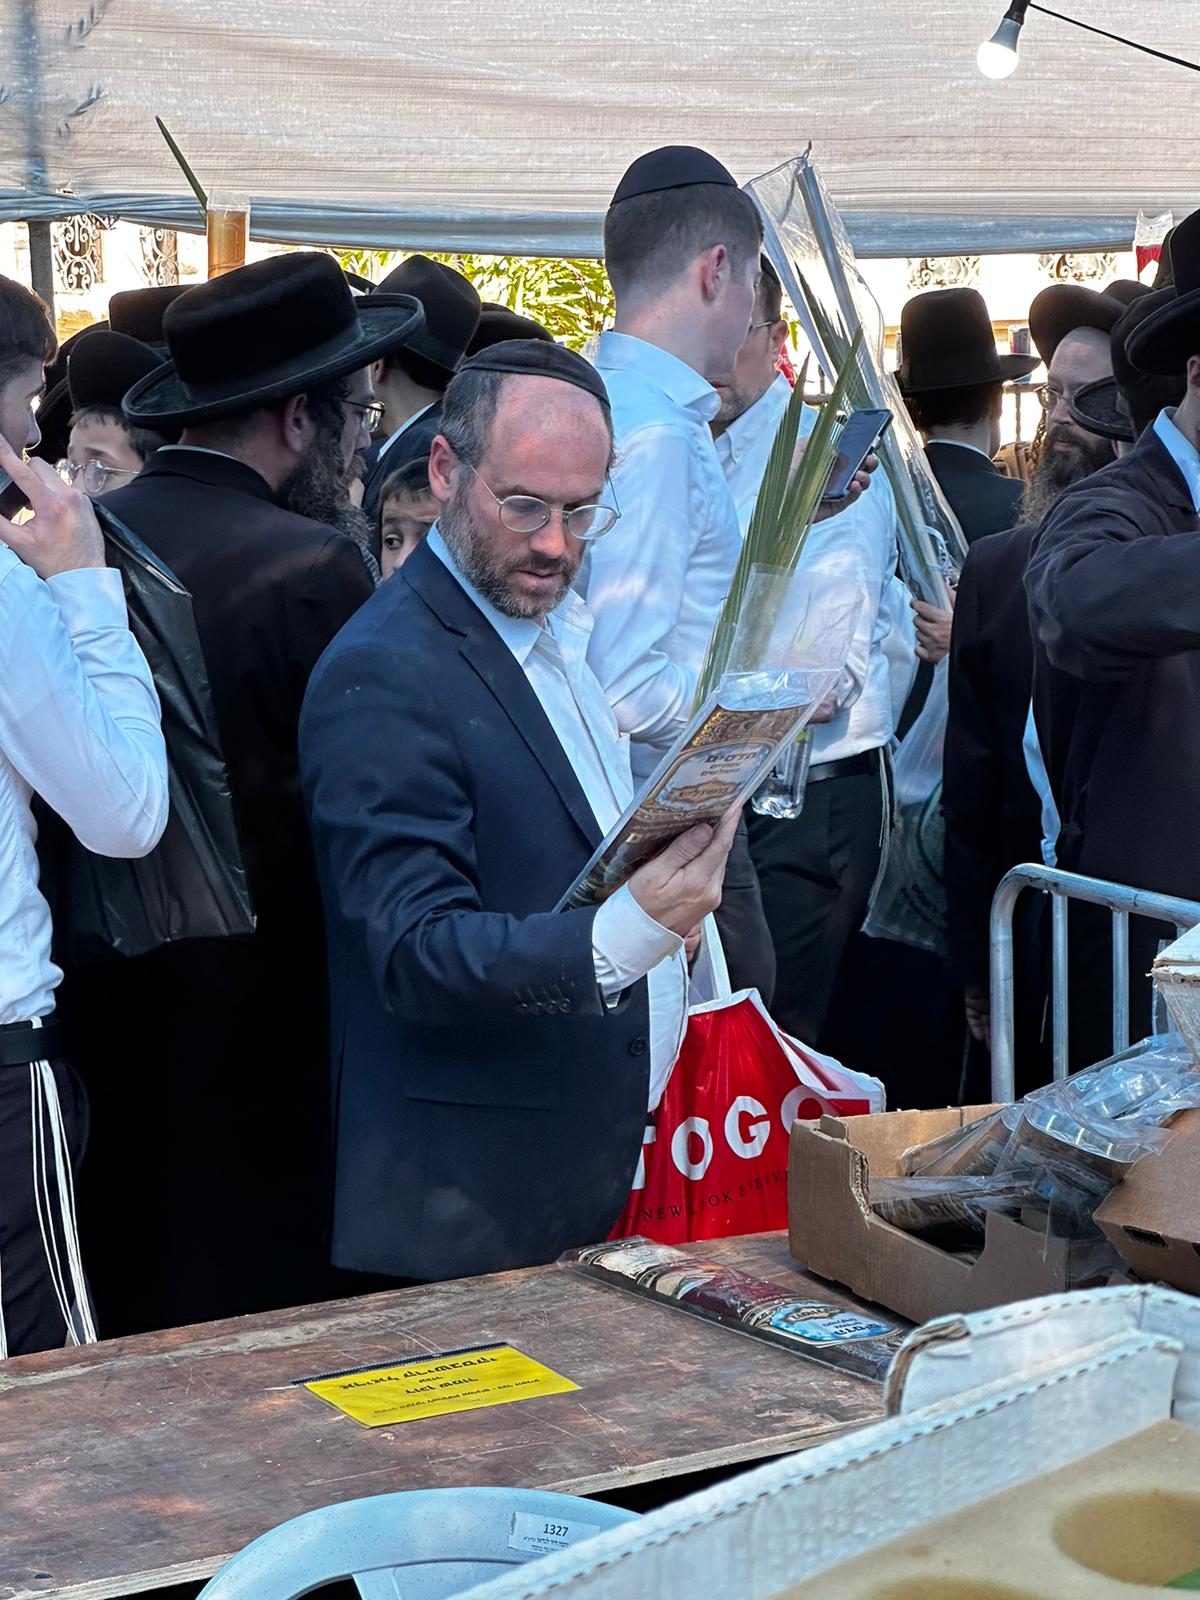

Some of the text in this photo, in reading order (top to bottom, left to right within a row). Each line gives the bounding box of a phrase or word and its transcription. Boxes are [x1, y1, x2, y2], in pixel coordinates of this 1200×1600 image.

[704, 752, 757, 763] הדסים
[643, 1204, 682, 1221] NEW
[339, 1376, 400, 1390] אריאל
[405, 1377, 479, 1395] דוכן שמור
[543, 1523, 569, 1537] 1327
